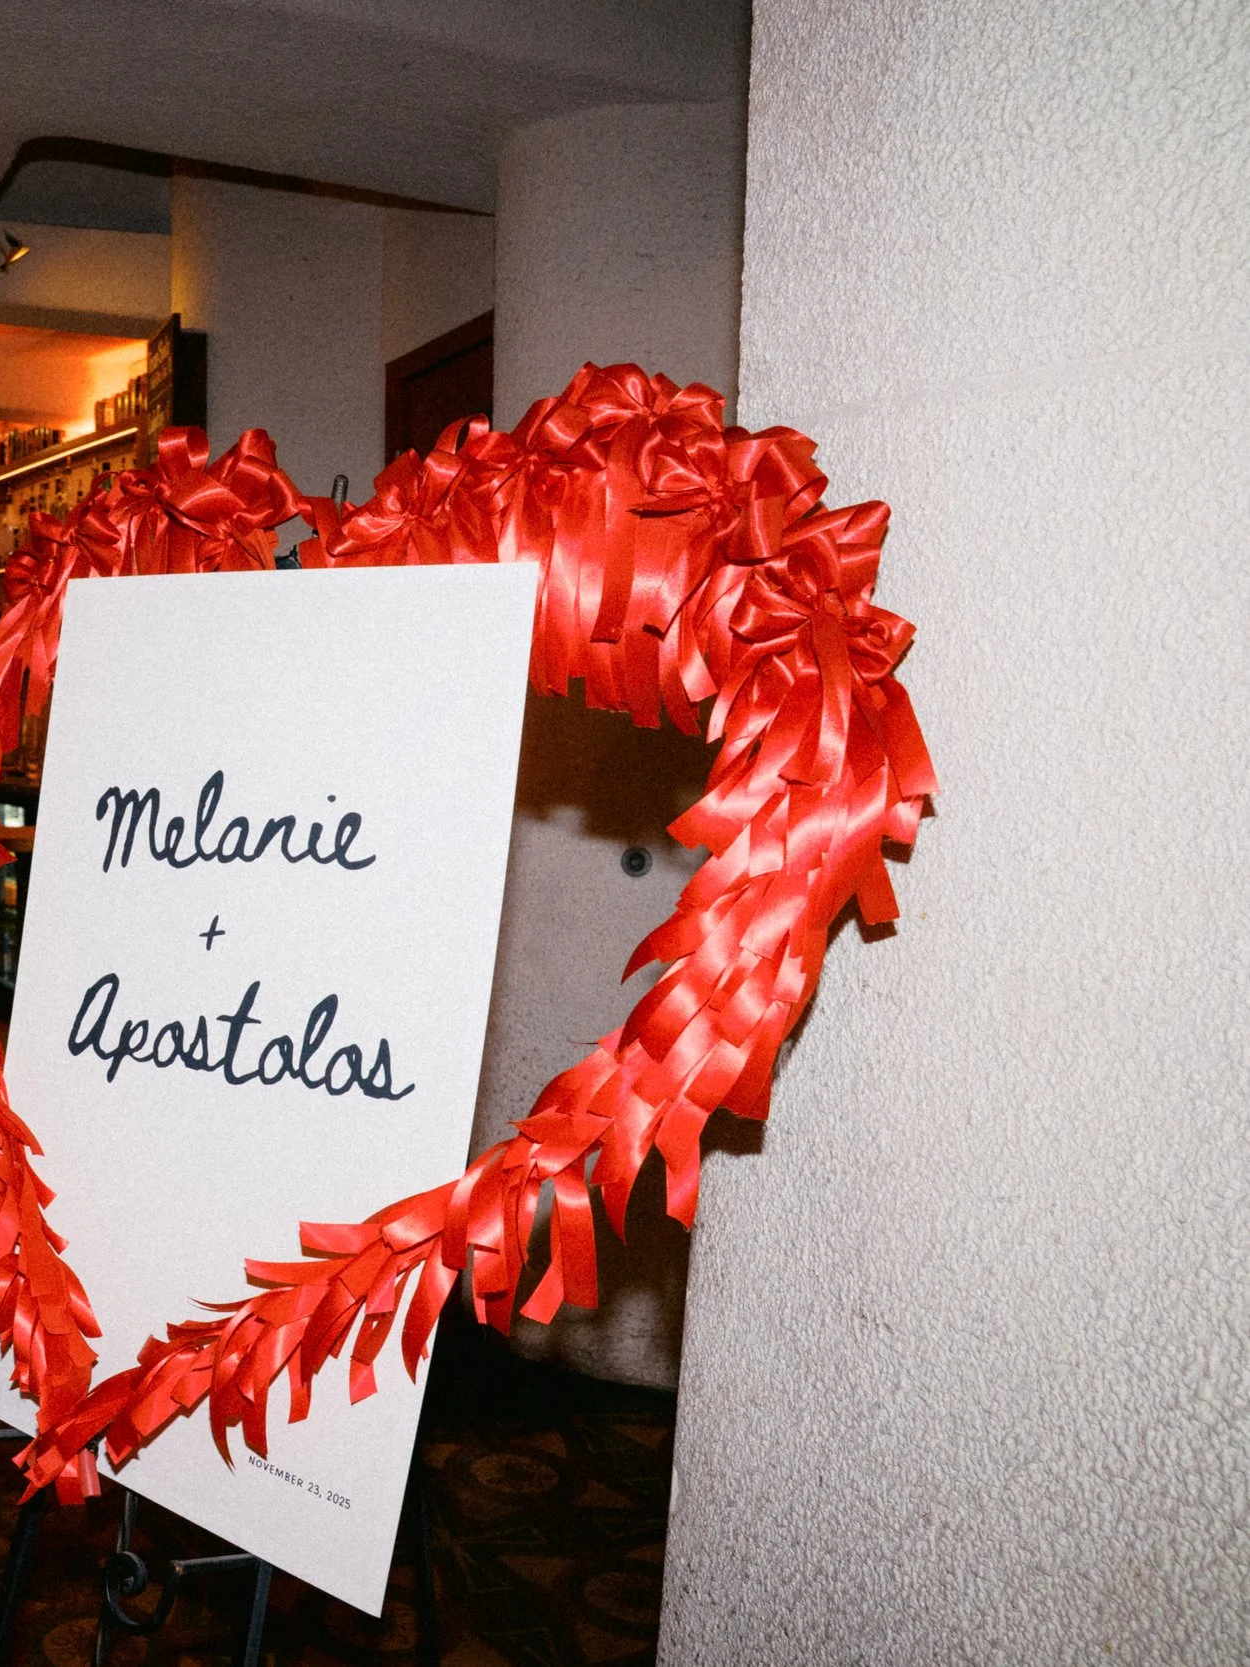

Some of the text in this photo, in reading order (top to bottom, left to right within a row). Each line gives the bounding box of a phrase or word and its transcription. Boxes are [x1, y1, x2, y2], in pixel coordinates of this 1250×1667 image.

[95, 770, 377, 873] Melanie
[199, 915, 226, 951] +
[248, 1455, 351, 1510] NOVEMBER 23, 2025
